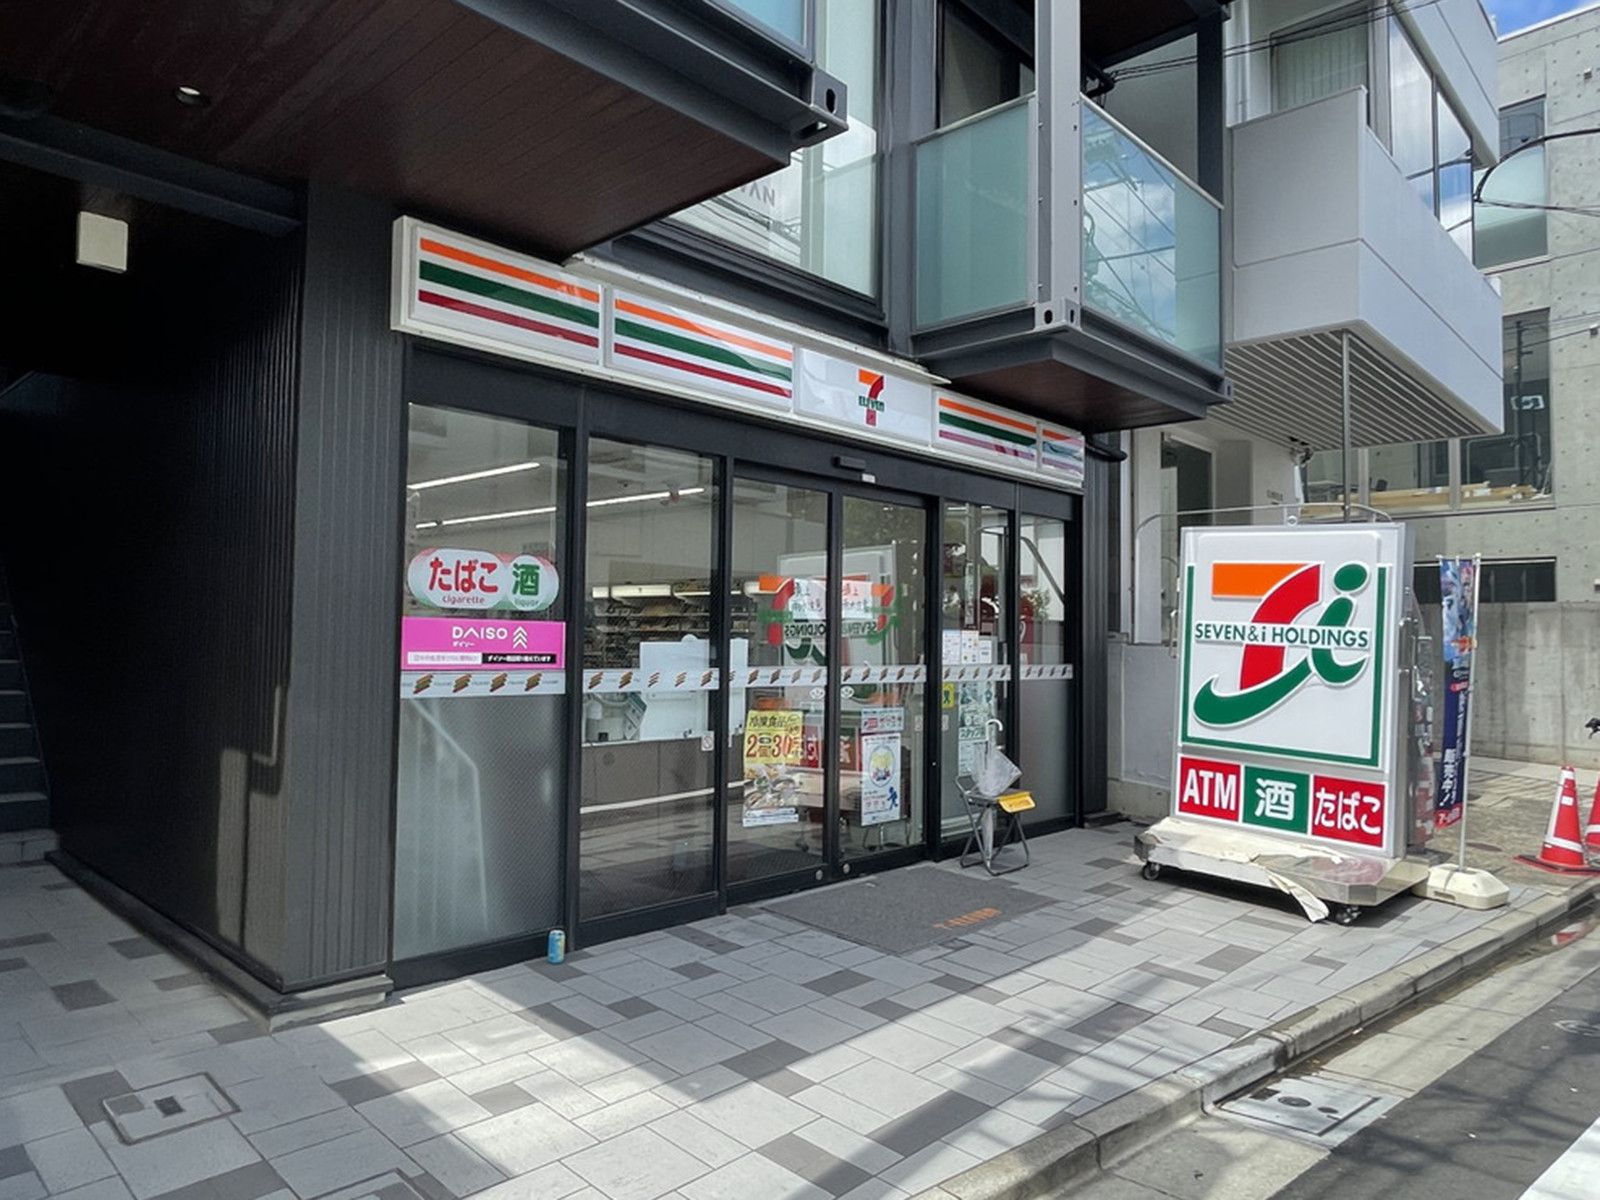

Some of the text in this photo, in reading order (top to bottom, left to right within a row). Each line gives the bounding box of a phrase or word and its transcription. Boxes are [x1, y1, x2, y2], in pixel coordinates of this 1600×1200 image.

[428, 557, 540, 596] たばこ 酒
[452, 626, 508, 640] DAISO
[1272, 627, 1368, 647] HOLDINGS
[1182, 768, 1237, 811] ATM
[1254, 777, 1381, 835] 酒 たばこ
